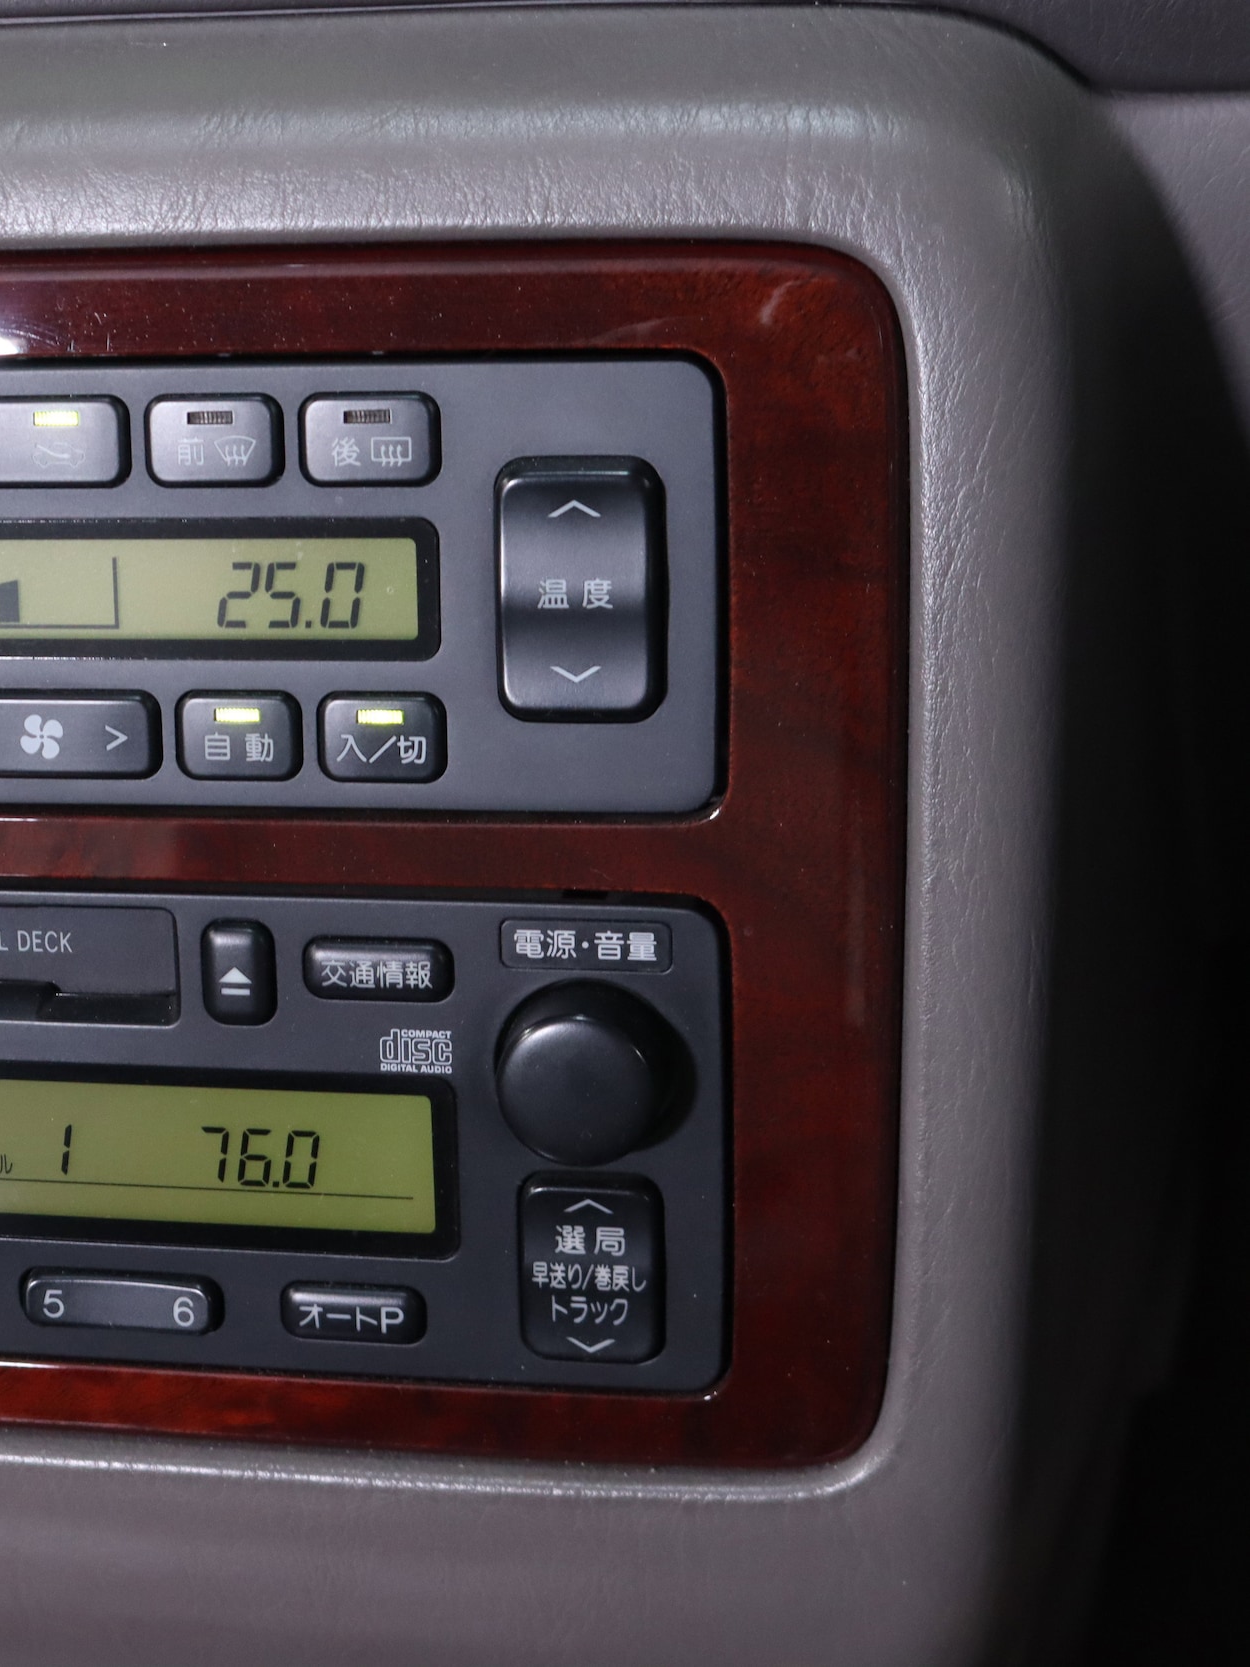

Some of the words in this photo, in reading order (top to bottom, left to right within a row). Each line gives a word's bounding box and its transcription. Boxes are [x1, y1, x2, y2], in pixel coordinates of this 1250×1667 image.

[177, 437, 205, 465] 前
[331, 437, 361, 466] 後
[217, 562, 365, 629] 25.0
[537, 577, 614, 609] 温度
[204, 732, 275, 762] 自動
[17, 930, 73, 953] DECK
[514, 928, 658, 962] 電源・音量
[321, 959, 433, 990] 交通情報
[379, 1029, 453, 1066] disc
[401, 1029, 452, 1039] COMPACT
[380, 1063, 418, 1073] DIGITAL
[420, 1065, 453, 1074] AUDIO
[61, 1124, 72, 1175] 1
[201, 1126, 320, 1189] 76.0
[555, 1225, 626, 1257] 選局
[42, 1289, 65, 1318] 5
[173, 1297, 195, 1327] 6
[299, 1303, 405, 1335] オートP
[550, 1298, 628, 1326] トラック
